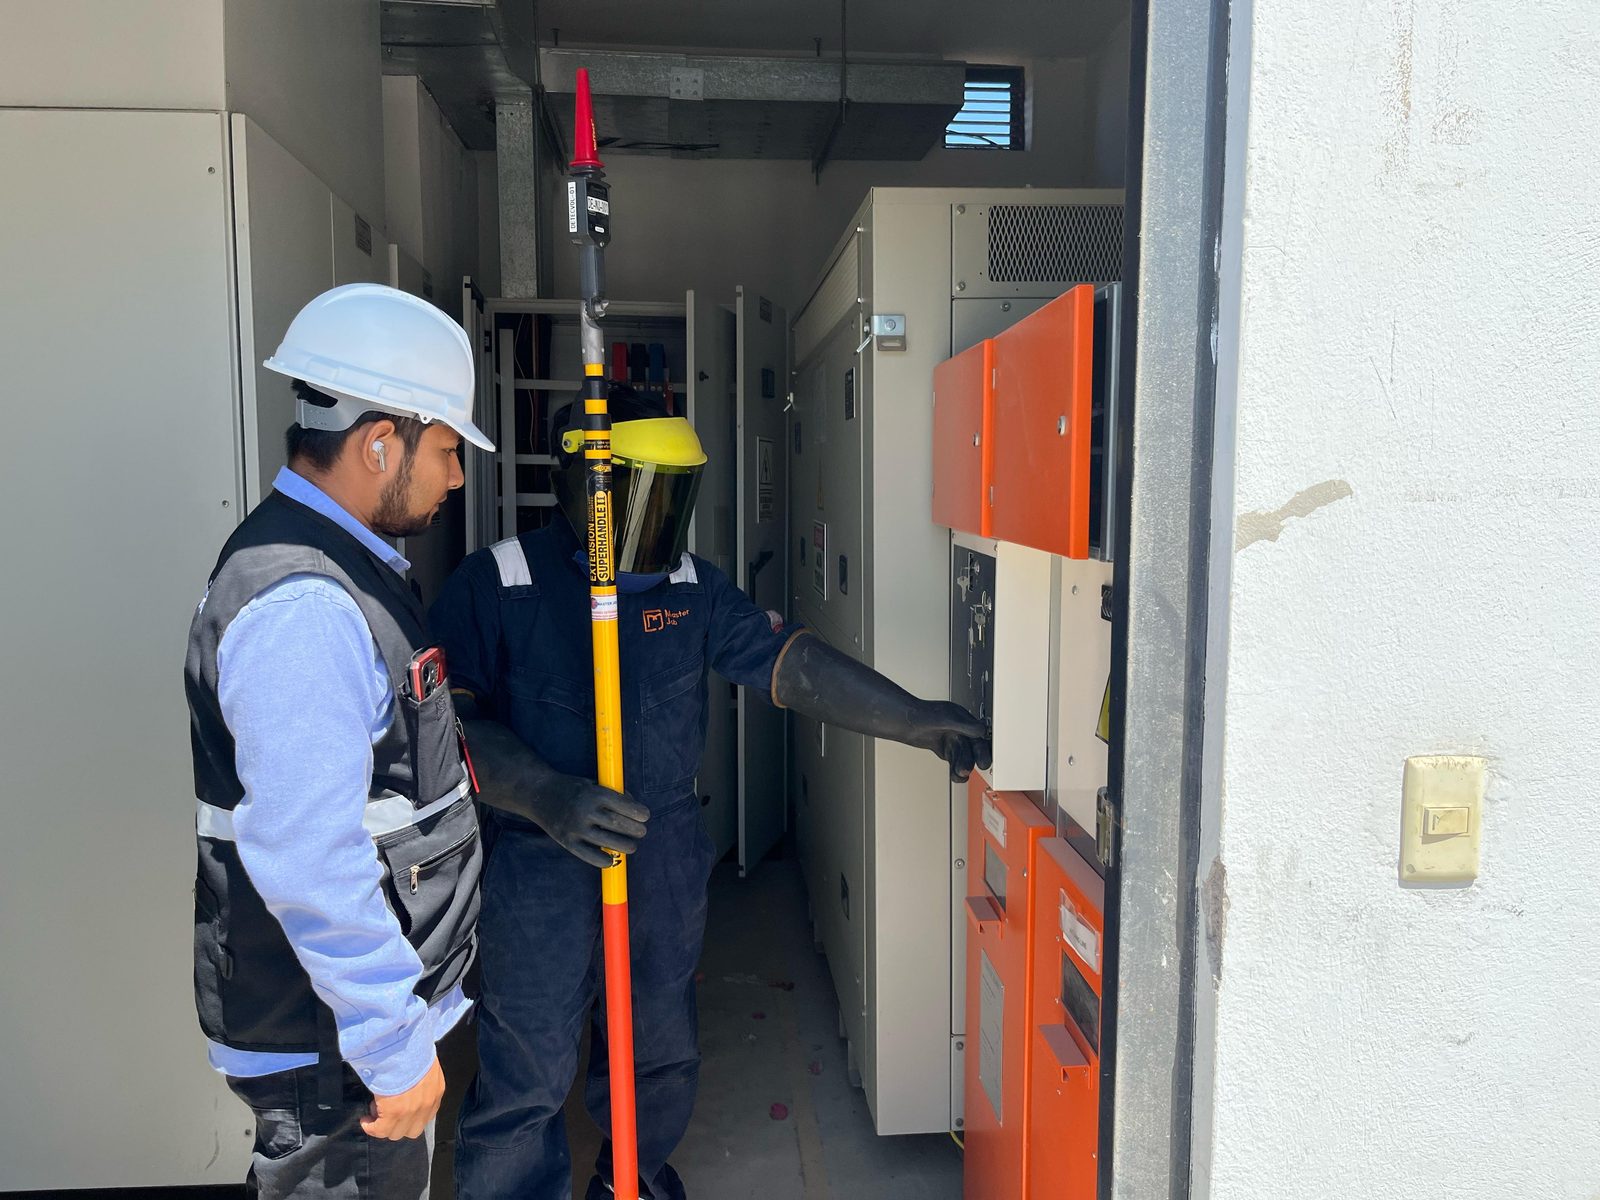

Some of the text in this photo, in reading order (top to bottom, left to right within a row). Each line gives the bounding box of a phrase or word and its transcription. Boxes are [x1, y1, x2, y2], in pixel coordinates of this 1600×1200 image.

[588, 523, 597, 581] EXTENSION
[664, 609, 689, 618] Master
[667, 617, 678, 625] Job
